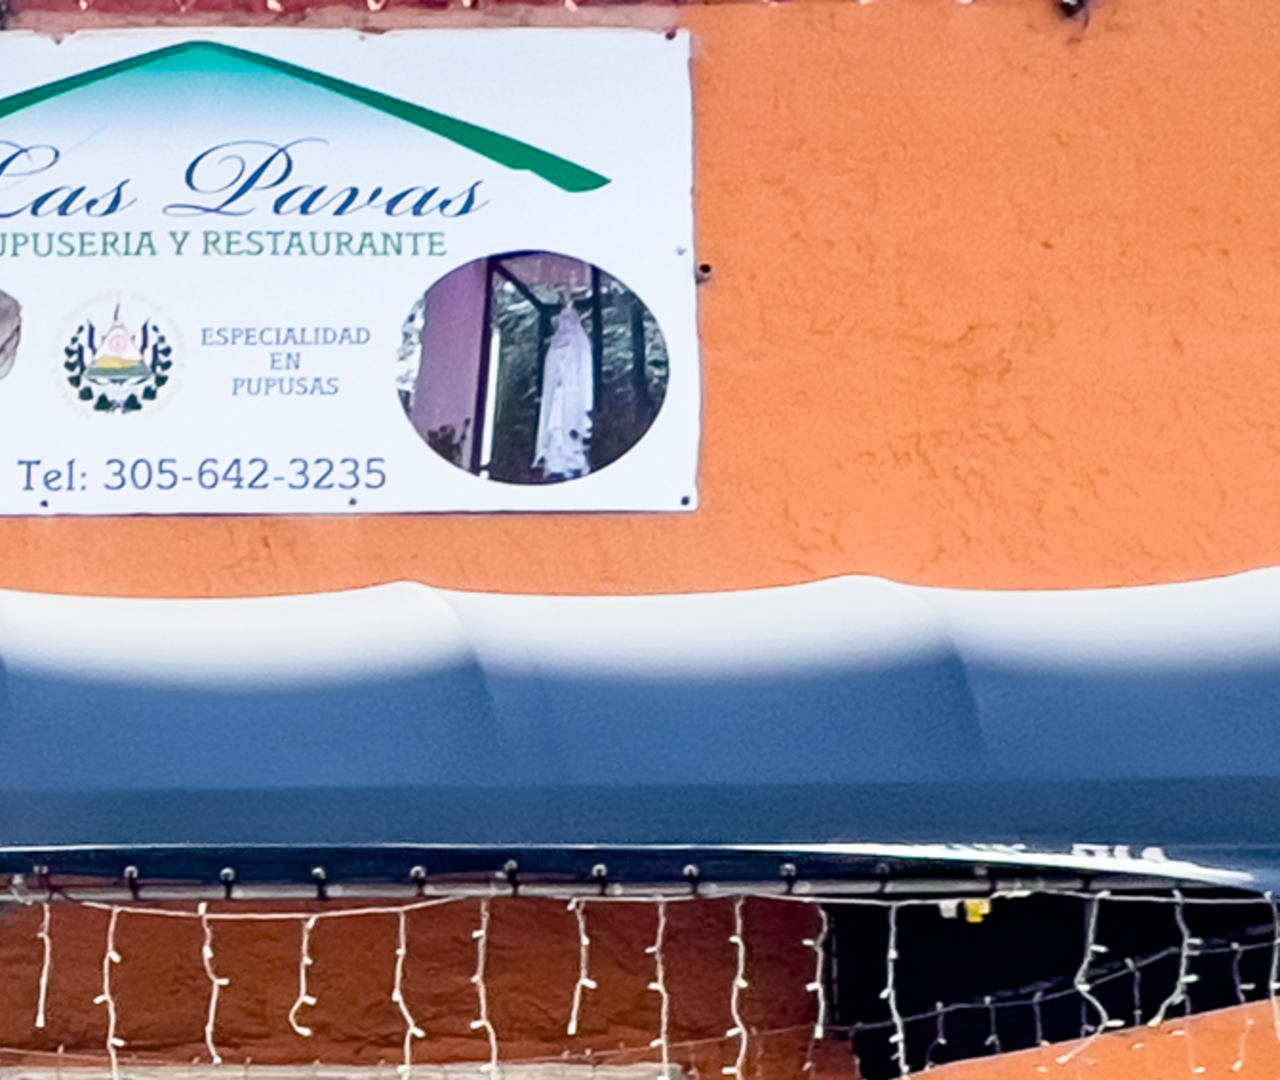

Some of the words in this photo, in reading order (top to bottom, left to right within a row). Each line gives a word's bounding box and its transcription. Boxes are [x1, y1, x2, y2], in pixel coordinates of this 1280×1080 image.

[164, 138, 490, 219] Pavas
[167, 231, 192, 258] Y
[201, 229, 447, 258] RESTAURANTE
[200, 326, 371, 347] ESPECIALIDAD
[269, 353, 302, 372] EN
[231, 376, 340, 397] PUPUSAS
[17, 459, 90, 492] Tel:
[102, 457, 388, 493] 305-642-3235
